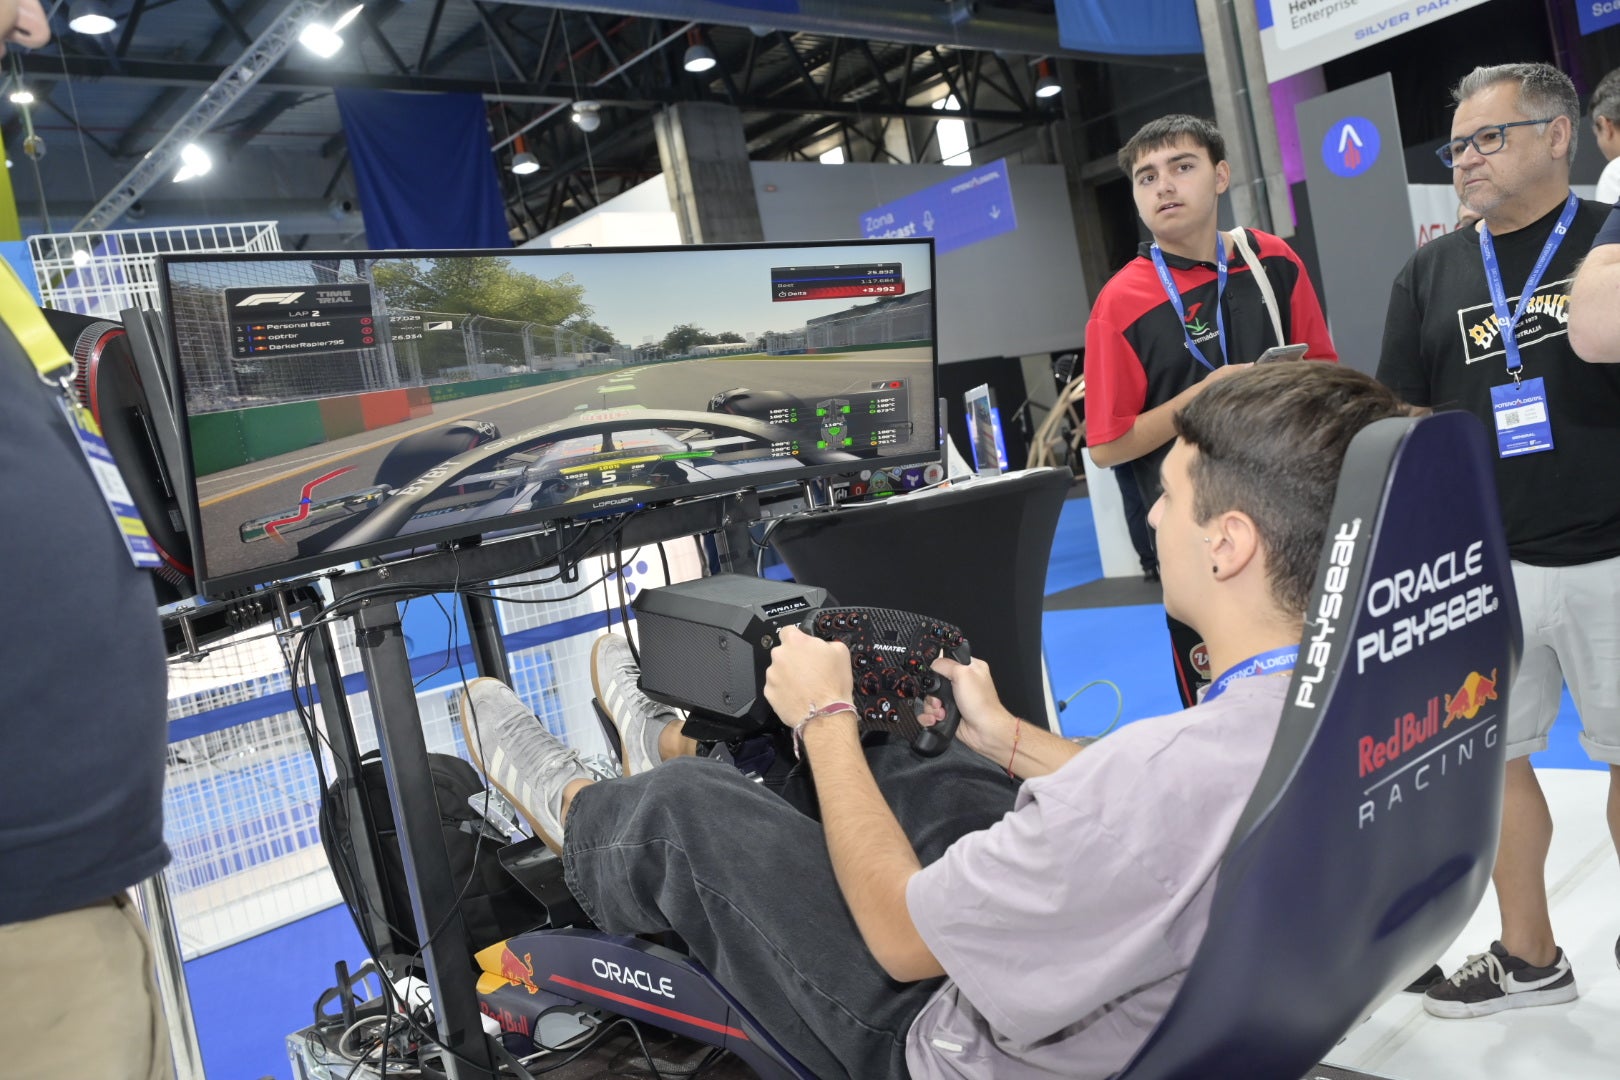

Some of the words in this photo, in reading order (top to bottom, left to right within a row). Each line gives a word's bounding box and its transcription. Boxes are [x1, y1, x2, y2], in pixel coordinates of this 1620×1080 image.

[1354, 12, 1410, 41] SILVER
[1416, 0, 1456, 16] PAR
[866, 212, 895, 232] Zona
[601, 469, 617, 484] 5
[1367, 540, 1483, 618] ORACLE
[873, 643, 907, 653] FANATEC
[1358, 724, 1497, 829] RACING
[592, 958, 676, 999] ORACLE
